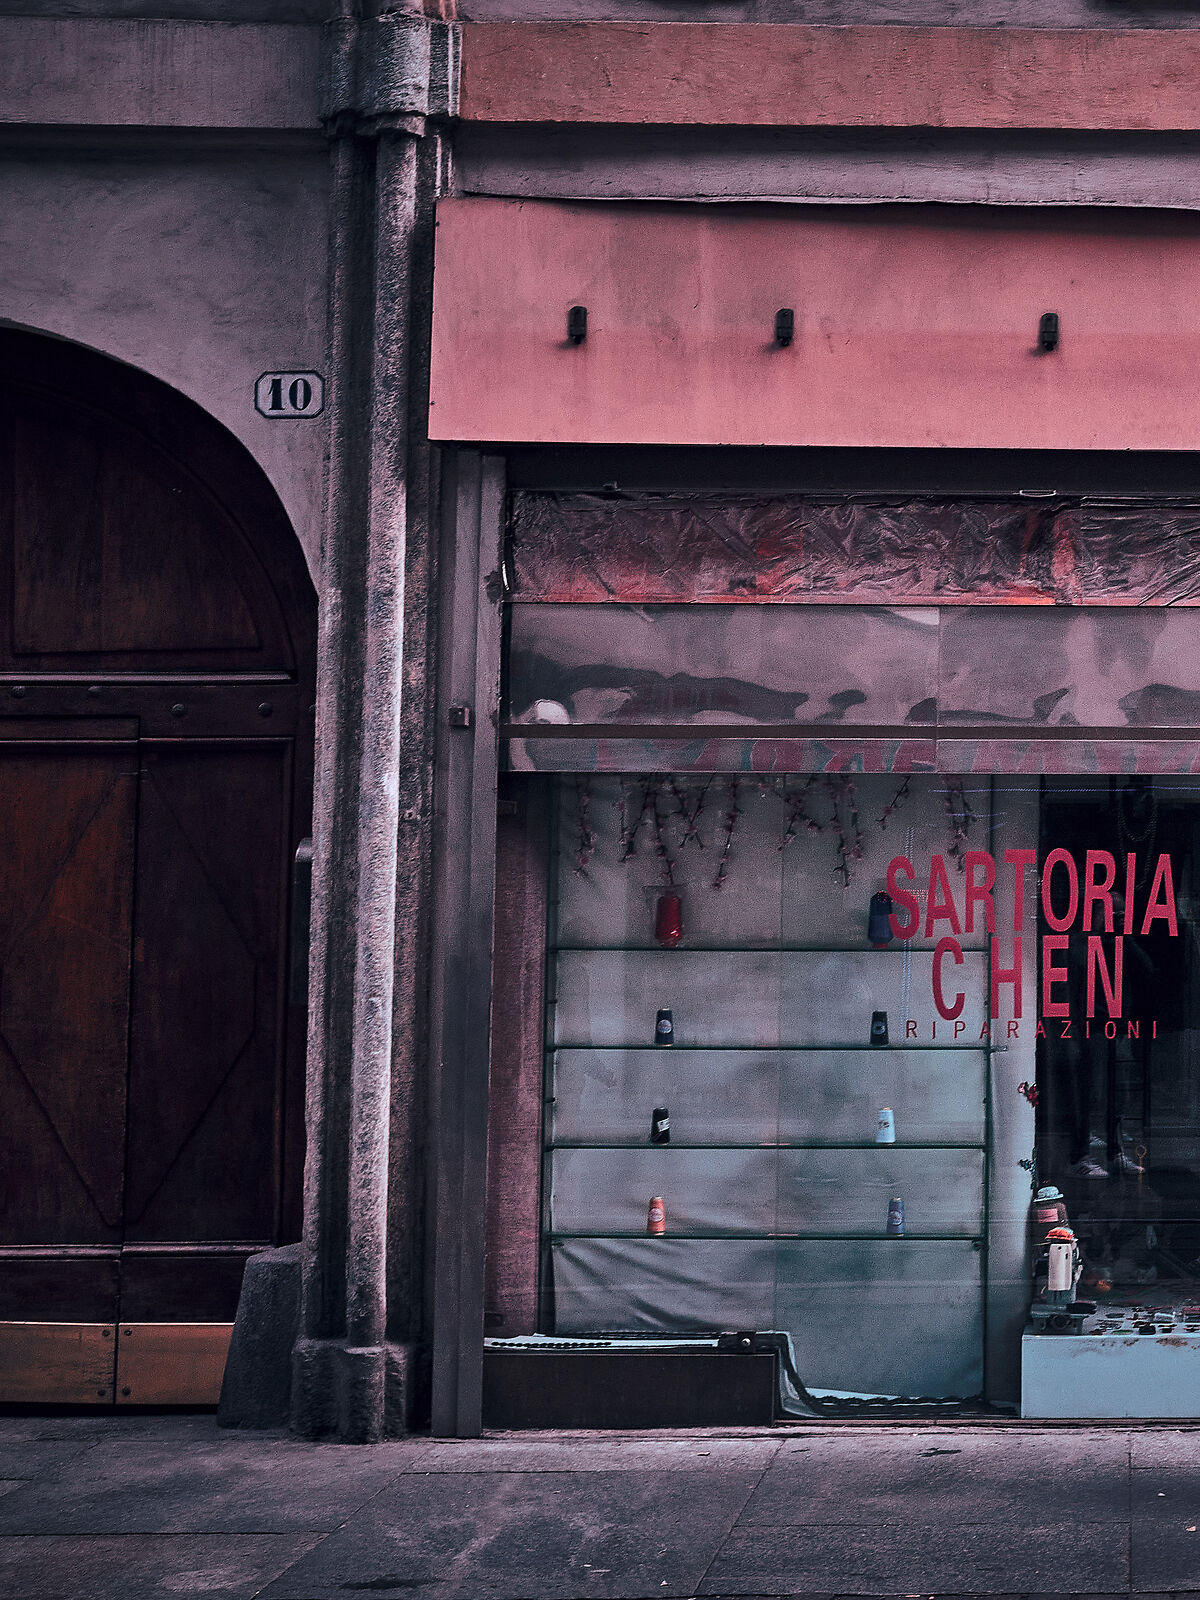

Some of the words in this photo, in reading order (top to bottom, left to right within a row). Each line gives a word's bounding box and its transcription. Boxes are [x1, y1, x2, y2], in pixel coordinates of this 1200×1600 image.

[268, 378, 312, 411] 10
[886, 848, 1179, 939] SARTORIA
[932, 935, 1124, 1020] CHEN
[905, 1020, 1157, 1038] RIPARAZIONI
